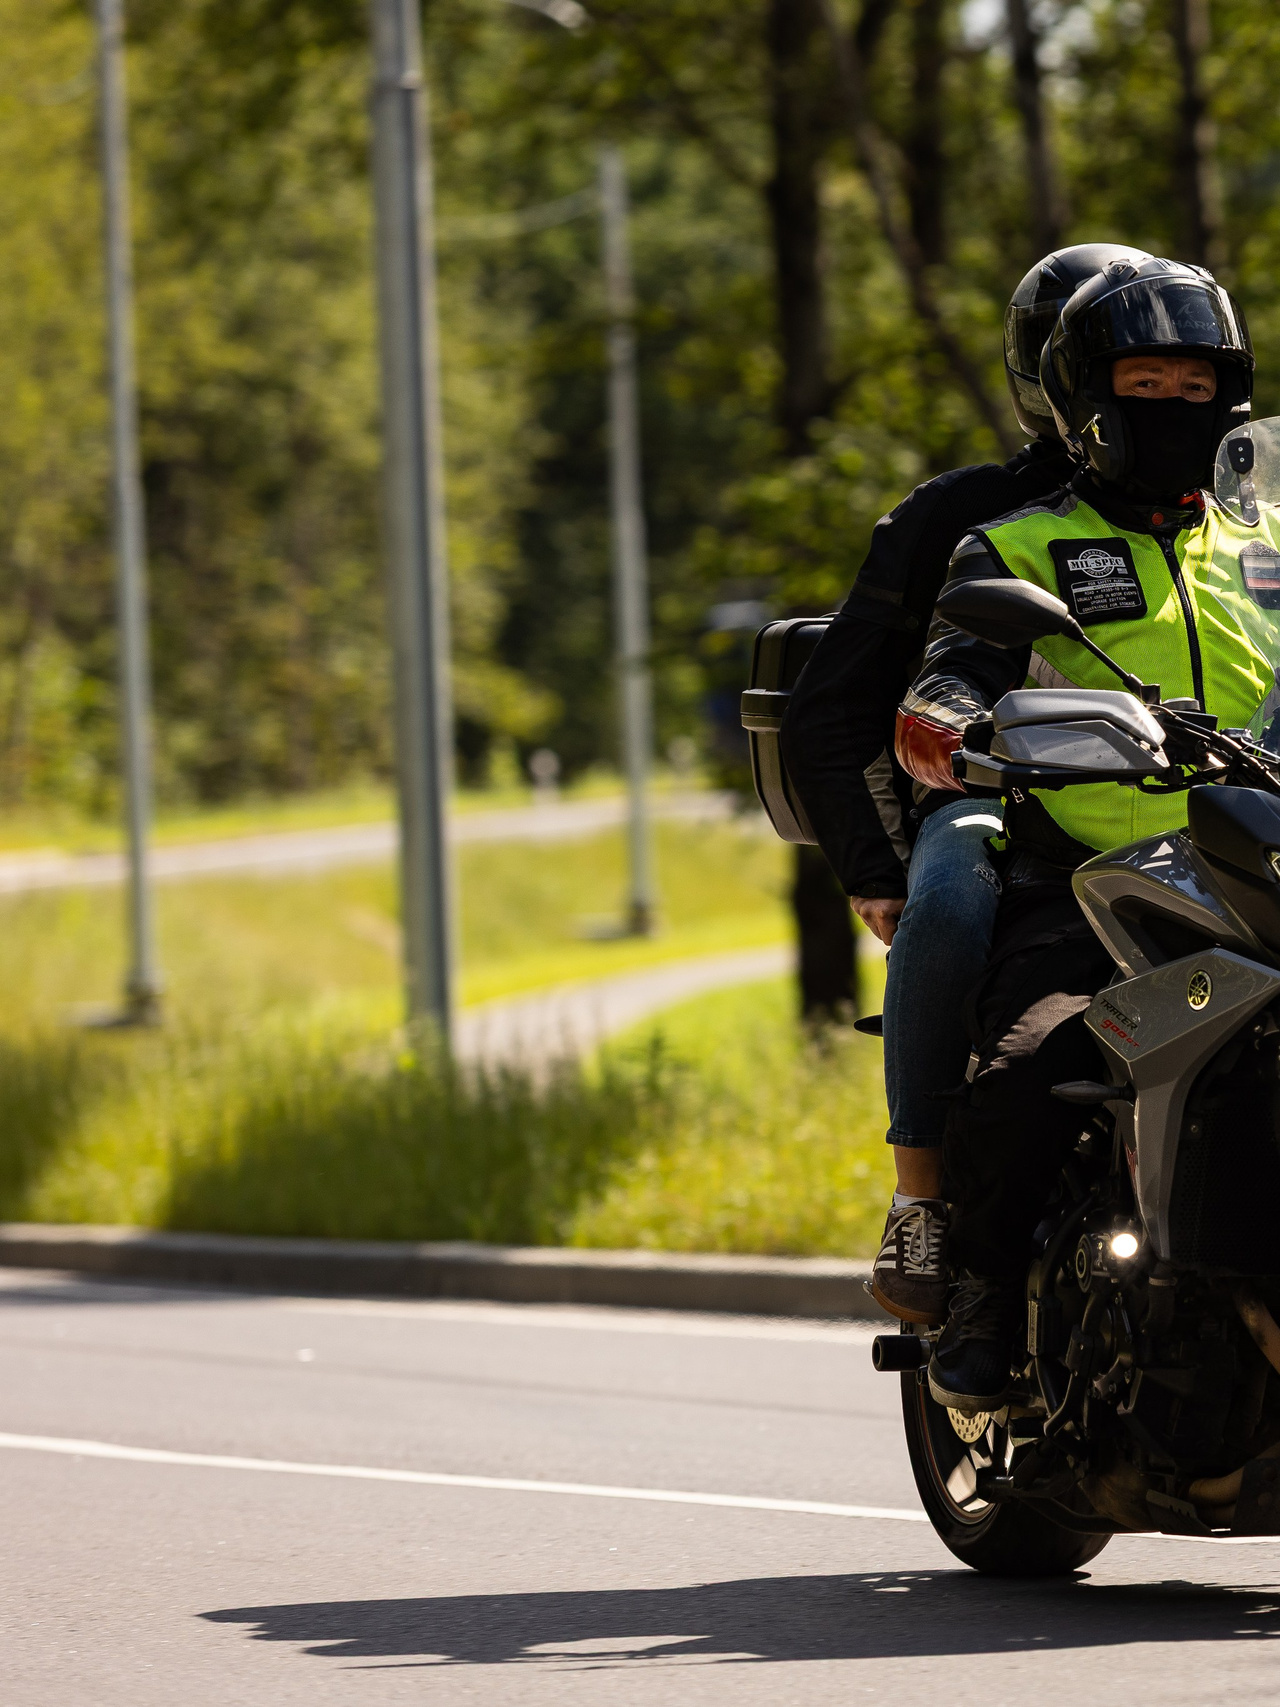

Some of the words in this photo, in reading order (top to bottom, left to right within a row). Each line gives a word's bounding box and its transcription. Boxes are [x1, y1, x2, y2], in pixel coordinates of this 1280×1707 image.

[1070, 558, 1122, 569] MIL-SPEC
[1100, 998, 1138, 1031] TRACER
[1100, 1019, 1128, 1039] 900
